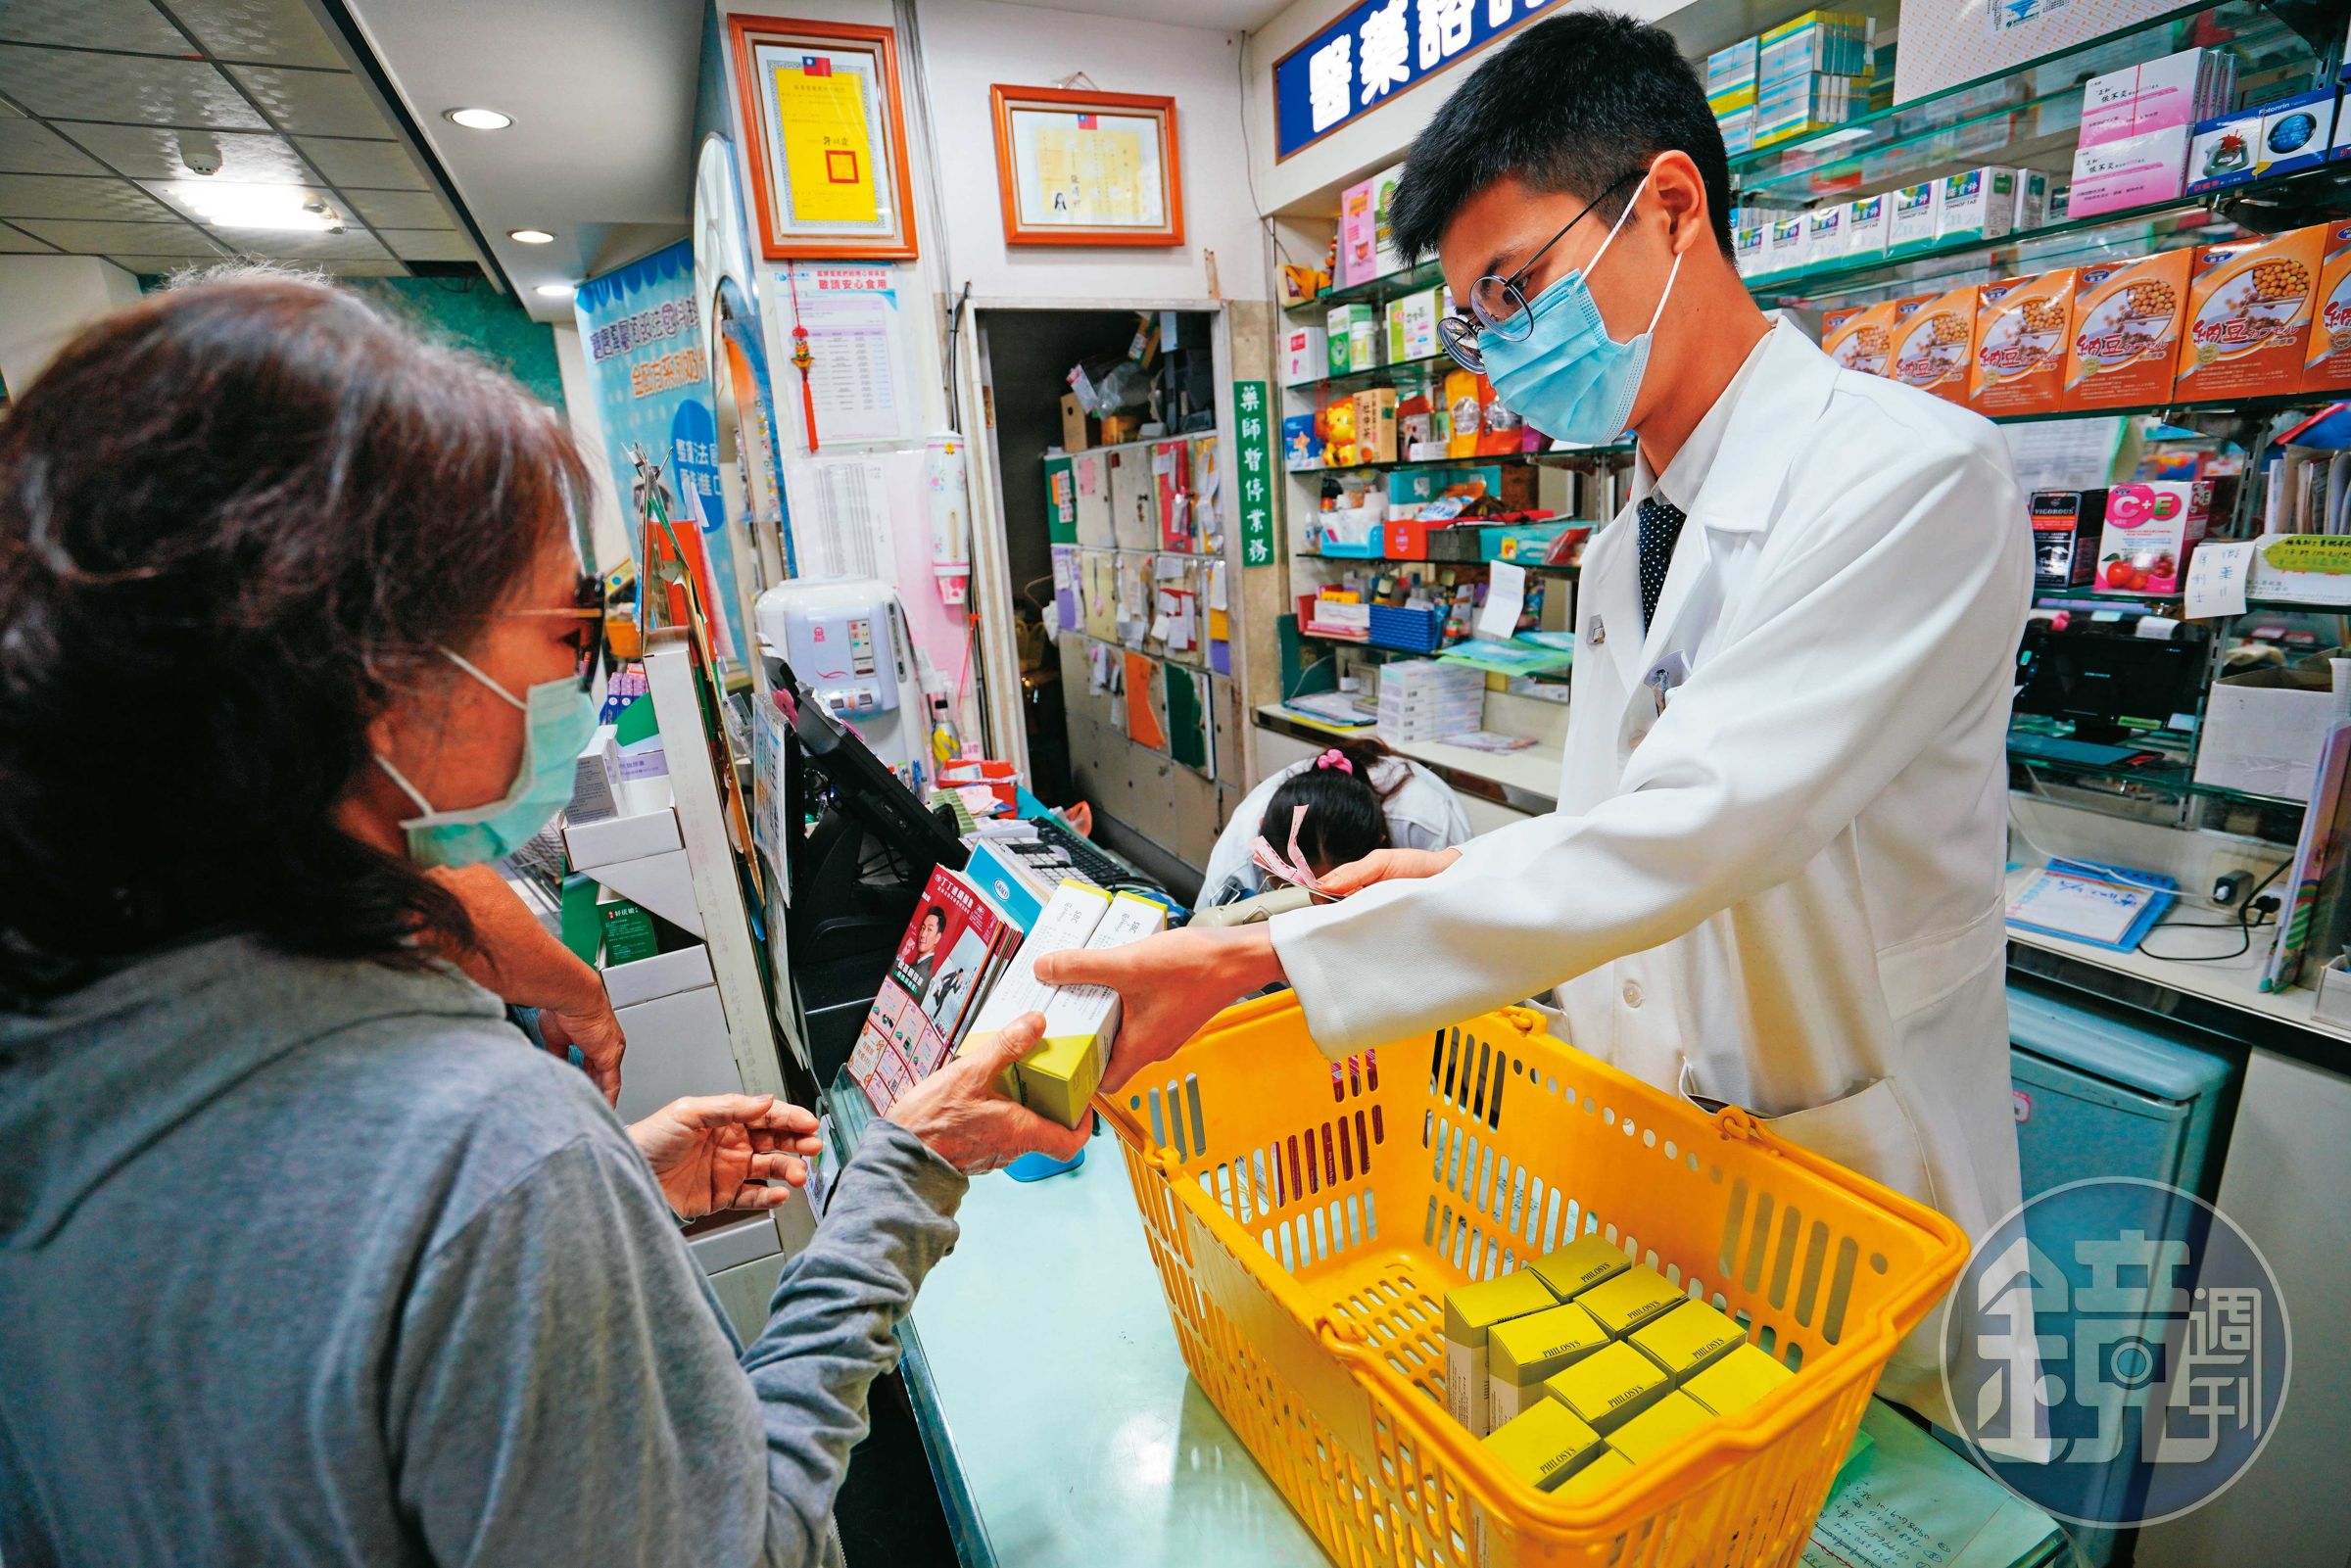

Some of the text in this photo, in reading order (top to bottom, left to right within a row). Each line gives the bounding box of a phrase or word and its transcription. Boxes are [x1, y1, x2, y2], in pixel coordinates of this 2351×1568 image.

[1309, 0, 1545, 133] 醫藥諮
[1240, 384, 1269, 563] 藥師暫停業務
[1580, 1260, 1612, 1284] PHILOSYS
[1626, 1300, 1660, 1320] PHILOSYS
[1542, 1339, 1582, 1358] PHILOSYS
[1692, 1337, 1726, 1360] PHILOSYS
[1607, 1384, 1645, 1408] PHILOSYS
[1539, 1446, 1577, 1475] PHILOSYS
